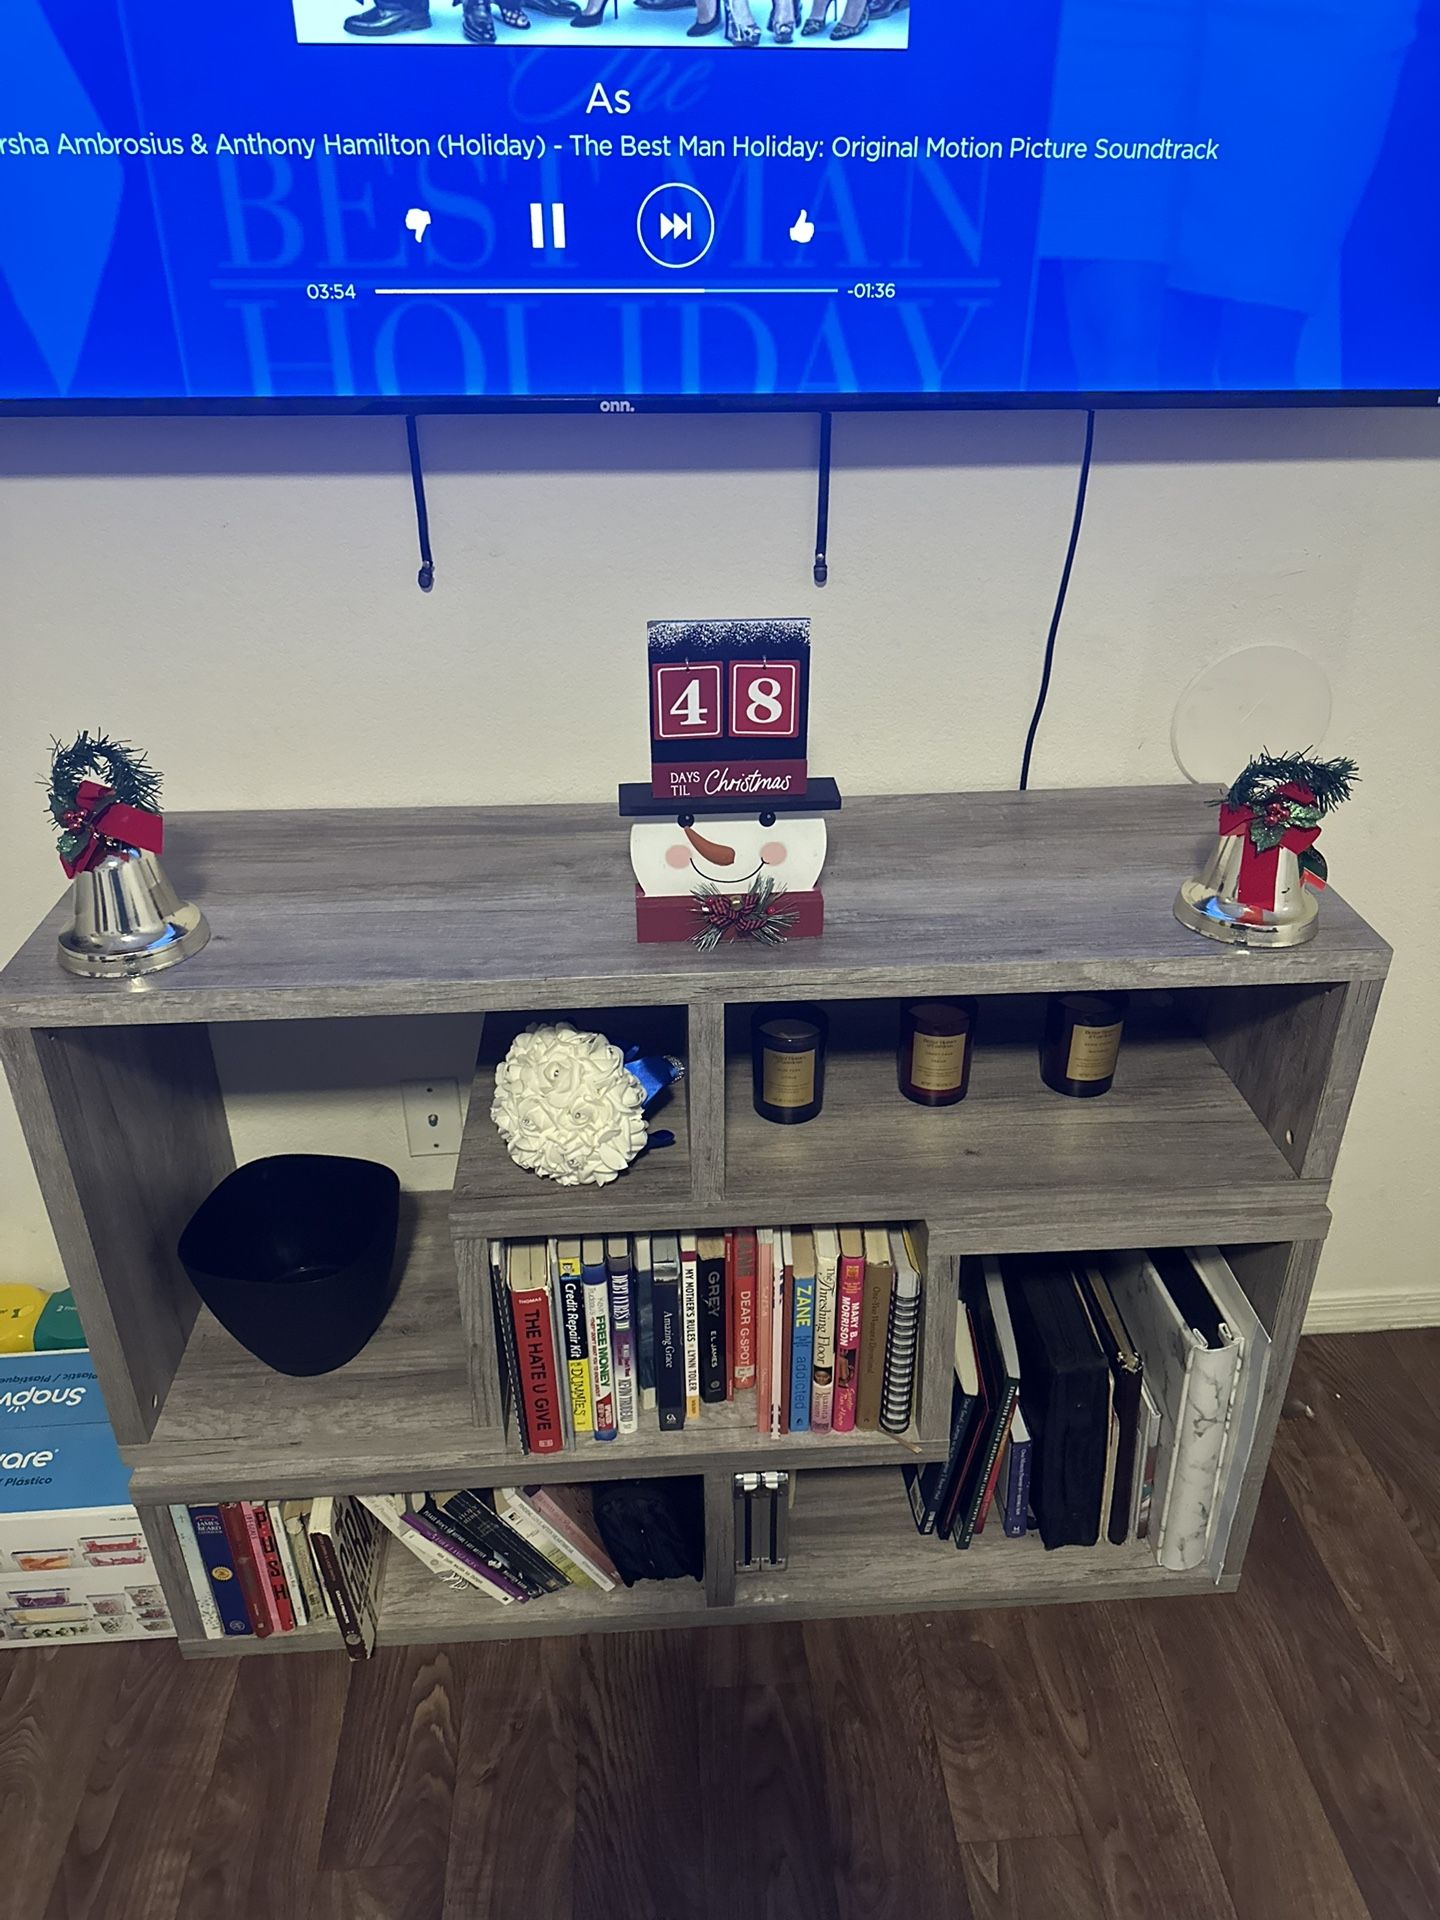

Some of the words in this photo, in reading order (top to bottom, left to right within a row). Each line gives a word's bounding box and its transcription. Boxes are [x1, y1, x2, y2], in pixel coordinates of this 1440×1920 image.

[585, 82, 631, 114] As
[57, 132, 184, 155] Ambrosius
[191, 133, 209, 154] &
[215, 133, 315, 159] Anthony
[323, 133, 430, 155] Hamilton
[437, 134, 546, 159] (Holiday)
[570, 134, 612, 156] The
[622, 135, 671, 156] Best
[679, 136, 725, 157] Man
[733, 134, 824, 161] Holiday:
[832, 136, 918, 162] Original
[926, 137, 1002, 158] Motion
[1010, 138, 1087, 159] Picture
[1094, 138, 1219, 159] Soundtrack
[306, 284, 356, 300] 03:54
[847, 283, 896, 299] -01:36
[600, 401, 635, 412] onn.
[670, 679, 708, 726] 4
[746, 677, 783, 724] 8
[670, 772, 700, 784] DAYS
[671, 785, 690, 796] TIL
[704, 768, 792, 796] Christmas
[612, 1275, 629, 1294] DEBT
[685, 1269, 693, 1279] MY
[827, 1267, 835, 1281] The
[565, 1283, 578, 1311] Credit
[685, 1281, 695, 1317] MOTHER'S
[708, 1272, 720, 1317] GREY
[740, 1291, 751, 1324] DEAR
[796, 1286, 812, 1327] ZANE
[815, 1272, 835, 1333] Threshing
[525, 1309, 542, 1339] THE
[567, 1312, 581, 1343] Repair
[662, 1311, 673, 1345] Amazing
[840, 1296, 851, 1347] MORRISON
[850, 1302, 860, 1327] MARY
[596, 1316, 606, 1345] FREE
[686, 1319, 695, 1342] RULES
[849, 1329, 858, 1342] B.
[571, 1344, 581, 1358] Kit
[665, 1345, 675, 1368] Grace
[688, 1349, 696, 1367] LYNN
[711, 1342, 719, 1368] JAMES
[740, 1328, 751, 1365] G-SPOT
[816, 1335, 830, 1365] Floor
[528, 1343, 547, 1380] HATE
[599, 1347, 610, 1387] MONEY
[532, 1384, 548, 1393] U
[570, 1368, 586, 1417] DUMMIES
[618, 1379, 632, 1396] KEVIN
[689, 1370, 697, 1391] TOLER
[795, 1357, 808, 1409] addicted
[533, 1398, 551, 1431] GIVE
[619, 1396, 633, 1423] TRUDEAU
